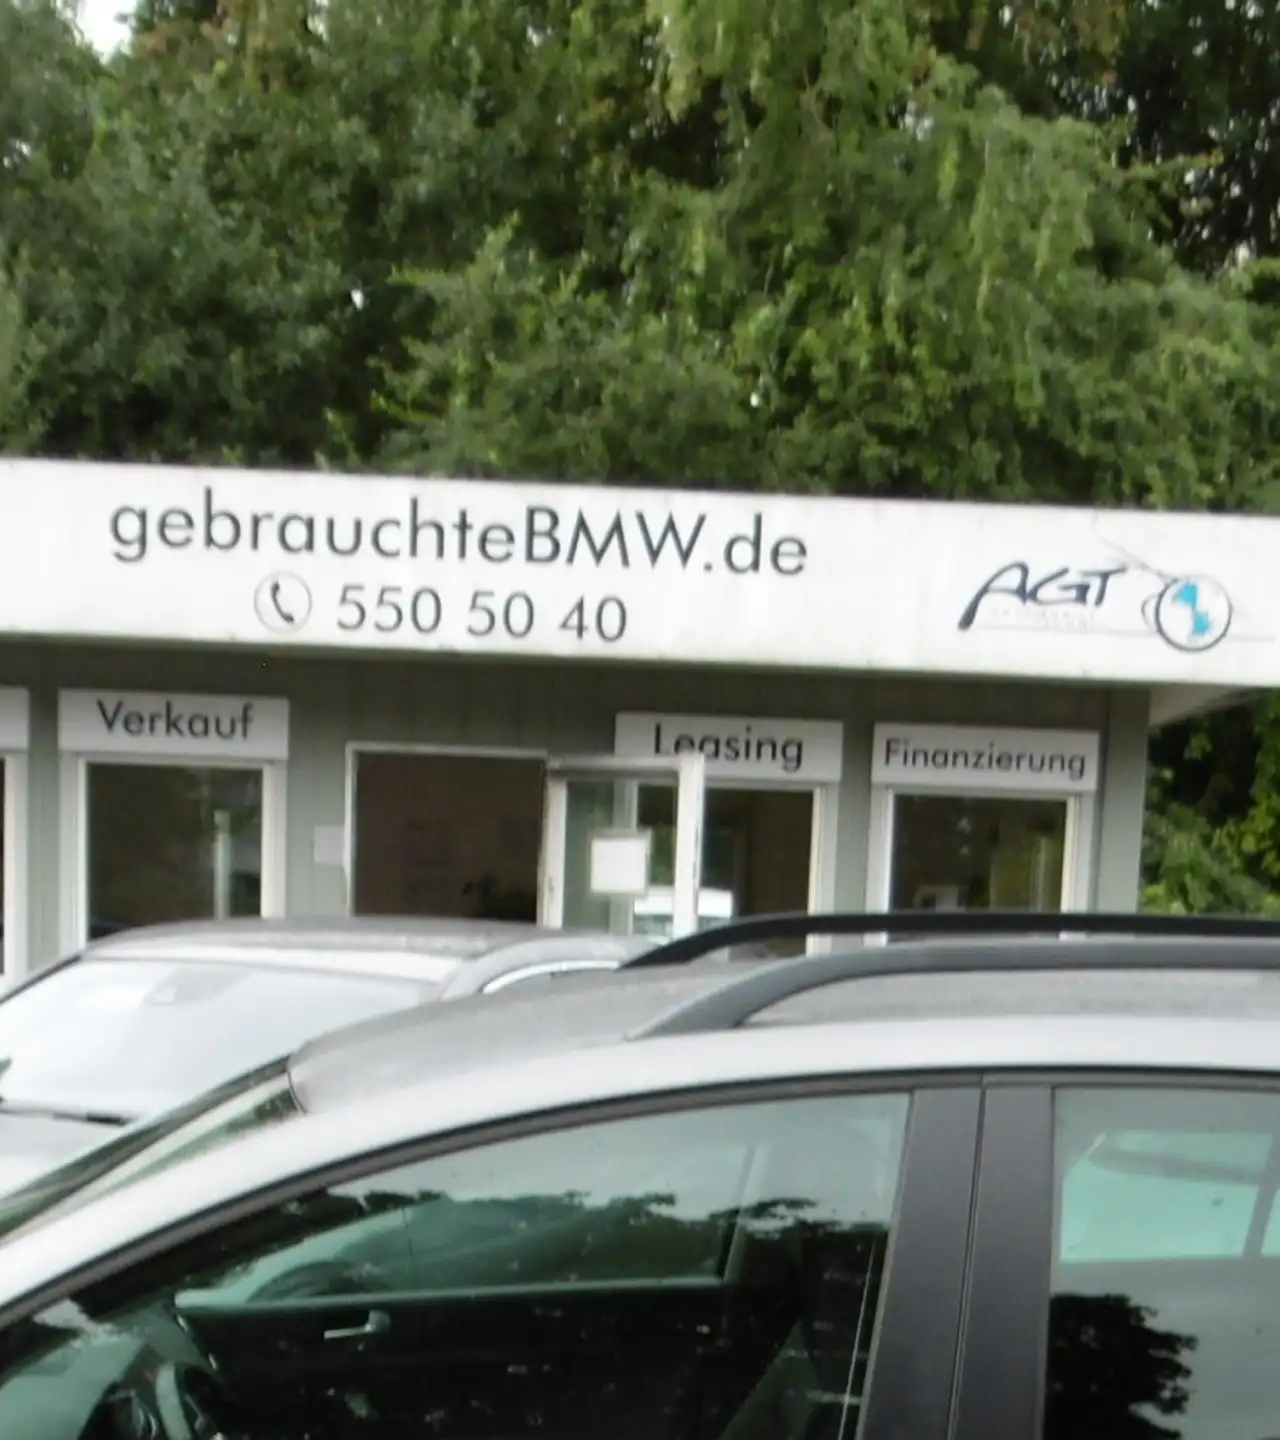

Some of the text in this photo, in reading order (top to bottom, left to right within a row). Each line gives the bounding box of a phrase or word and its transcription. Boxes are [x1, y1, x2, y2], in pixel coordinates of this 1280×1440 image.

[109, 486, 808, 576] gebrauchteBMW.de
[336, 584, 628, 642] 550 50 40
[958, 561, 1128, 631] AGT
[96, 698, 254, 740] Verkauf
[654, 723, 804, 773] Leasing
[885, 738, 1087, 781] Finanzierung
